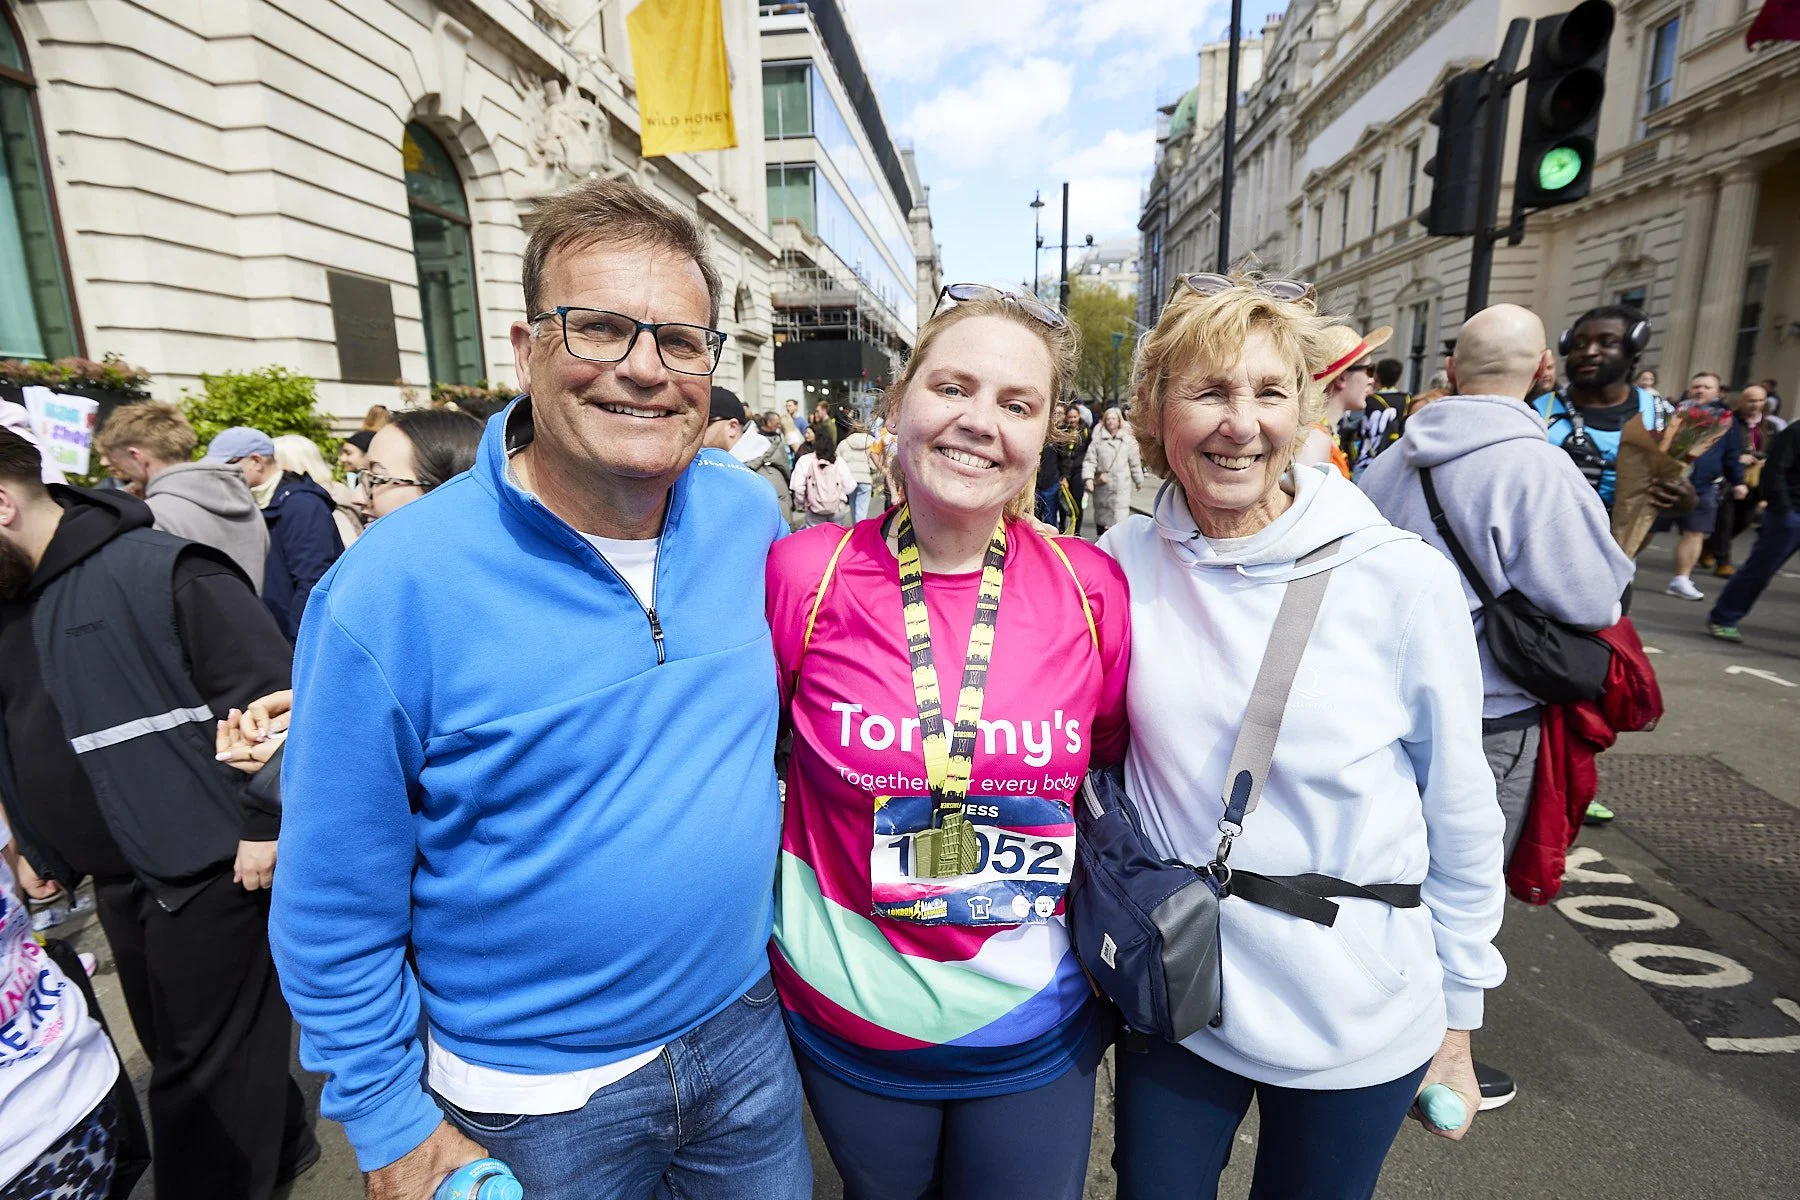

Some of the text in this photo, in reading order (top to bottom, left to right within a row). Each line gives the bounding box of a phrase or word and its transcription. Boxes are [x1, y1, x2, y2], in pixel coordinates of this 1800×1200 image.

[646, 112, 731, 127] WILD HONEY
[981, 777, 1037, 794] every
[1043, 771, 1079, 792] baby
[960, 804, 999, 818] JESS
[888, 833, 1063, 877] 1052
[887, 907, 914, 917] LONDON
